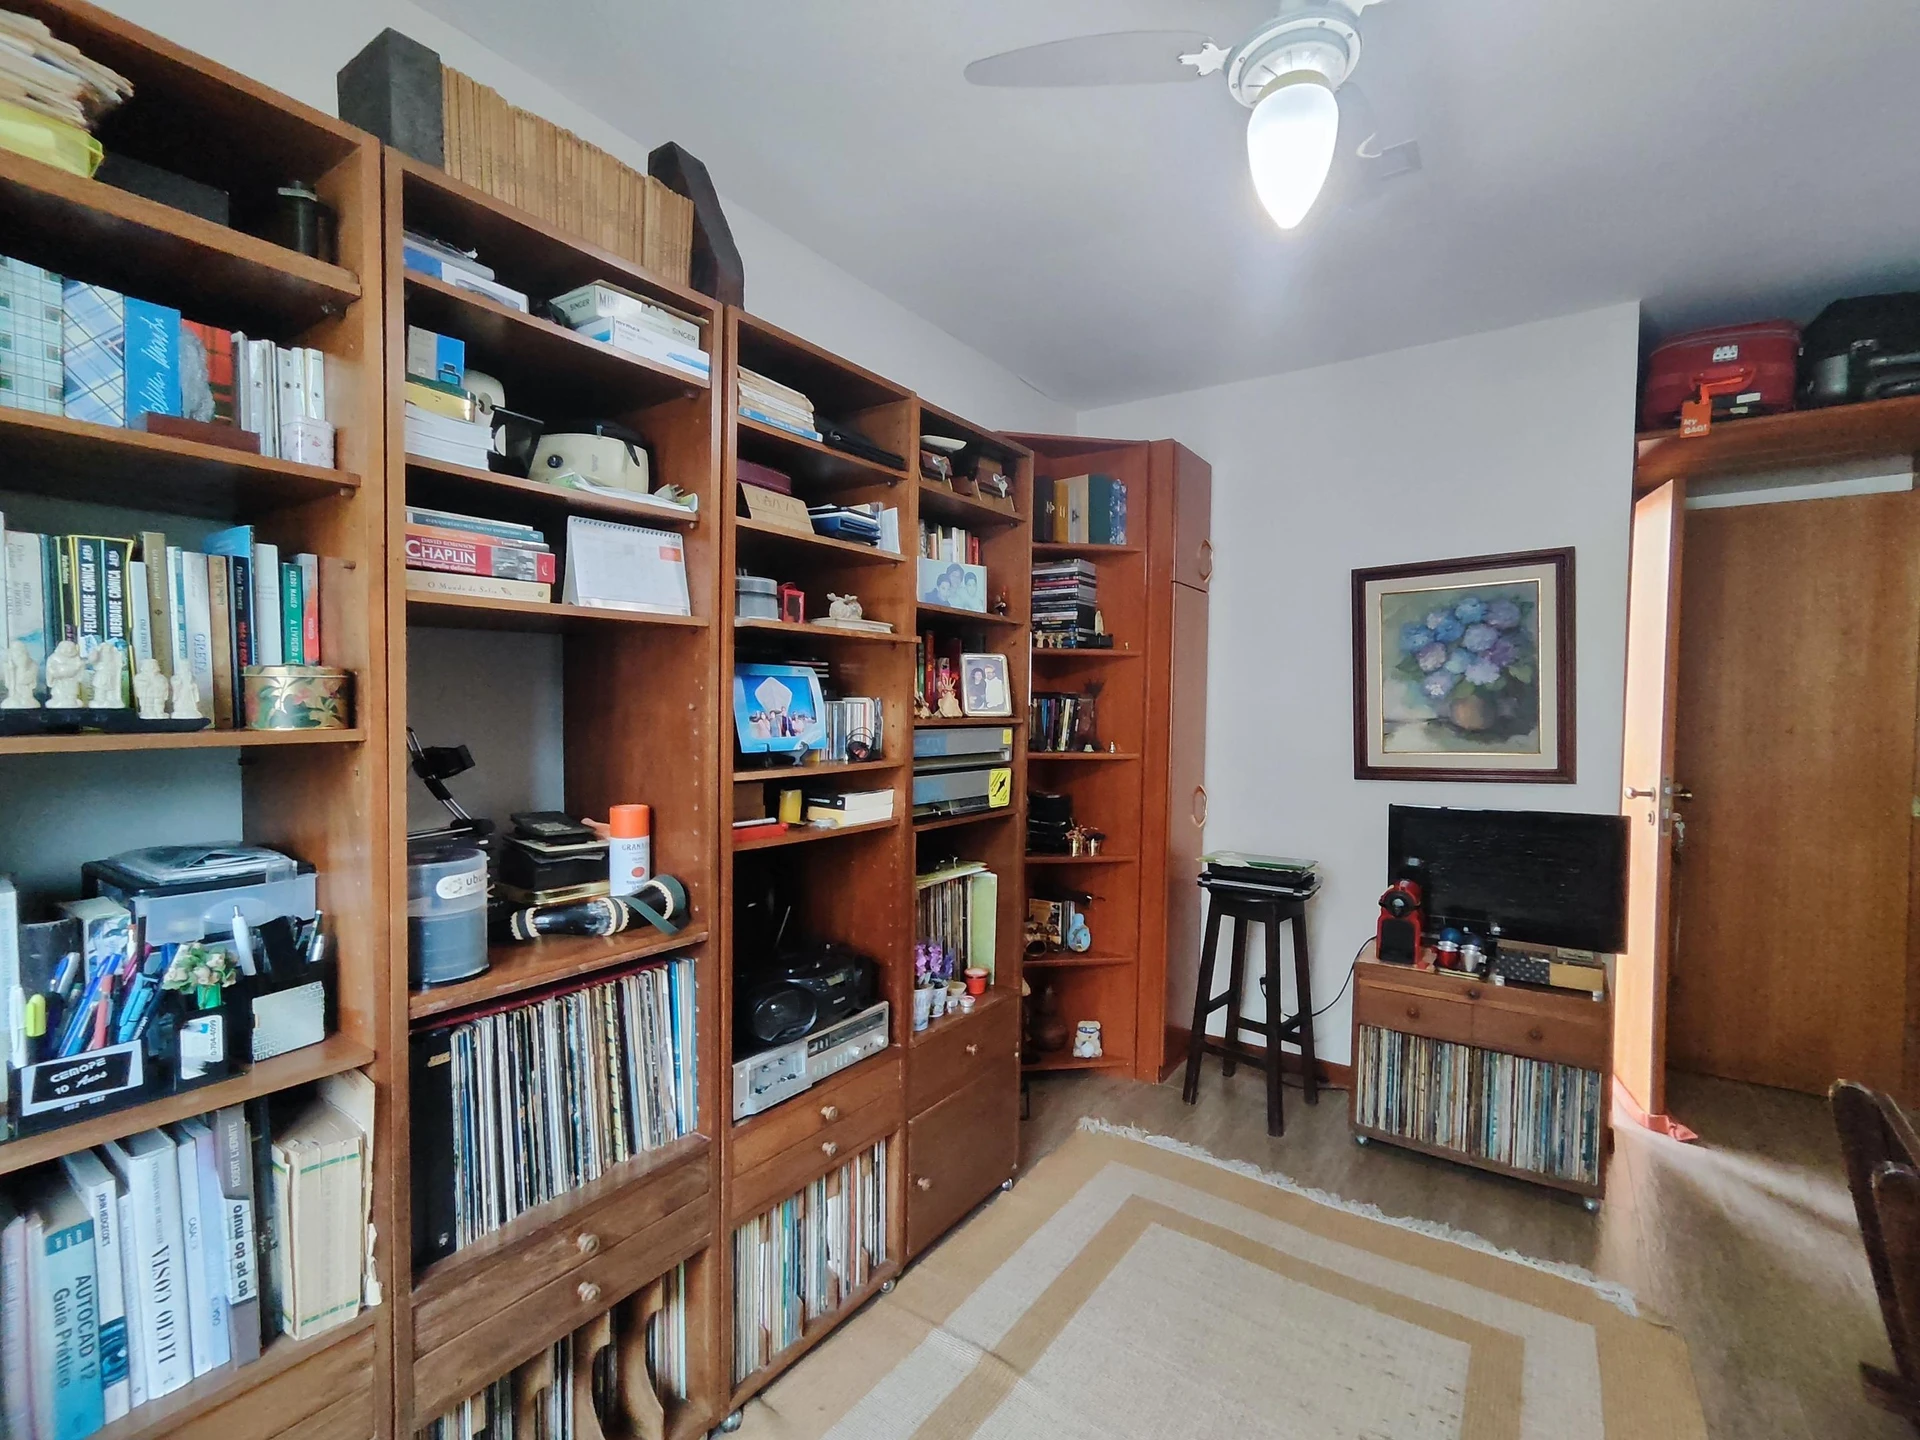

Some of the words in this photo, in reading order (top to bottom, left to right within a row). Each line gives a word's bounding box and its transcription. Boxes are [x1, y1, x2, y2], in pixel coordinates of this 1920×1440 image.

[570, 298, 590, 311] SINGER
[672, 327, 696, 342] SINGER
[406, 540, 476, 564] CHAPLIN
[442, 540, 476, 550] ROBINSON
[81, 563, 96, 593] CRÔNICA
[107, 570, 121, 599] CRÔNICA
[439, 583, 465, 591] Mundo
[83, 594, 97, 633] FELICIDADE
[109, 600, 123, 638] LIBERDADE
[291, 627, 299, 657] LIVREIRA
[50, 1057, 106, 1083] CEMOPE
[54, 1084, 70, 1095] 10
[229, 1158, 241, 1188] ROBERT
[232, 1204, 245, 1238] muro
[234, 1242, 246, 1259] do
[152, 1244, 172, 1304] COSTA
[237, 1280, 249, 1297] ao
[53, 1288, 71, 1327] Guia
[75, 1275, 95, 1358] AUTOCAD
[80, 1361, 97, 1382] 12
